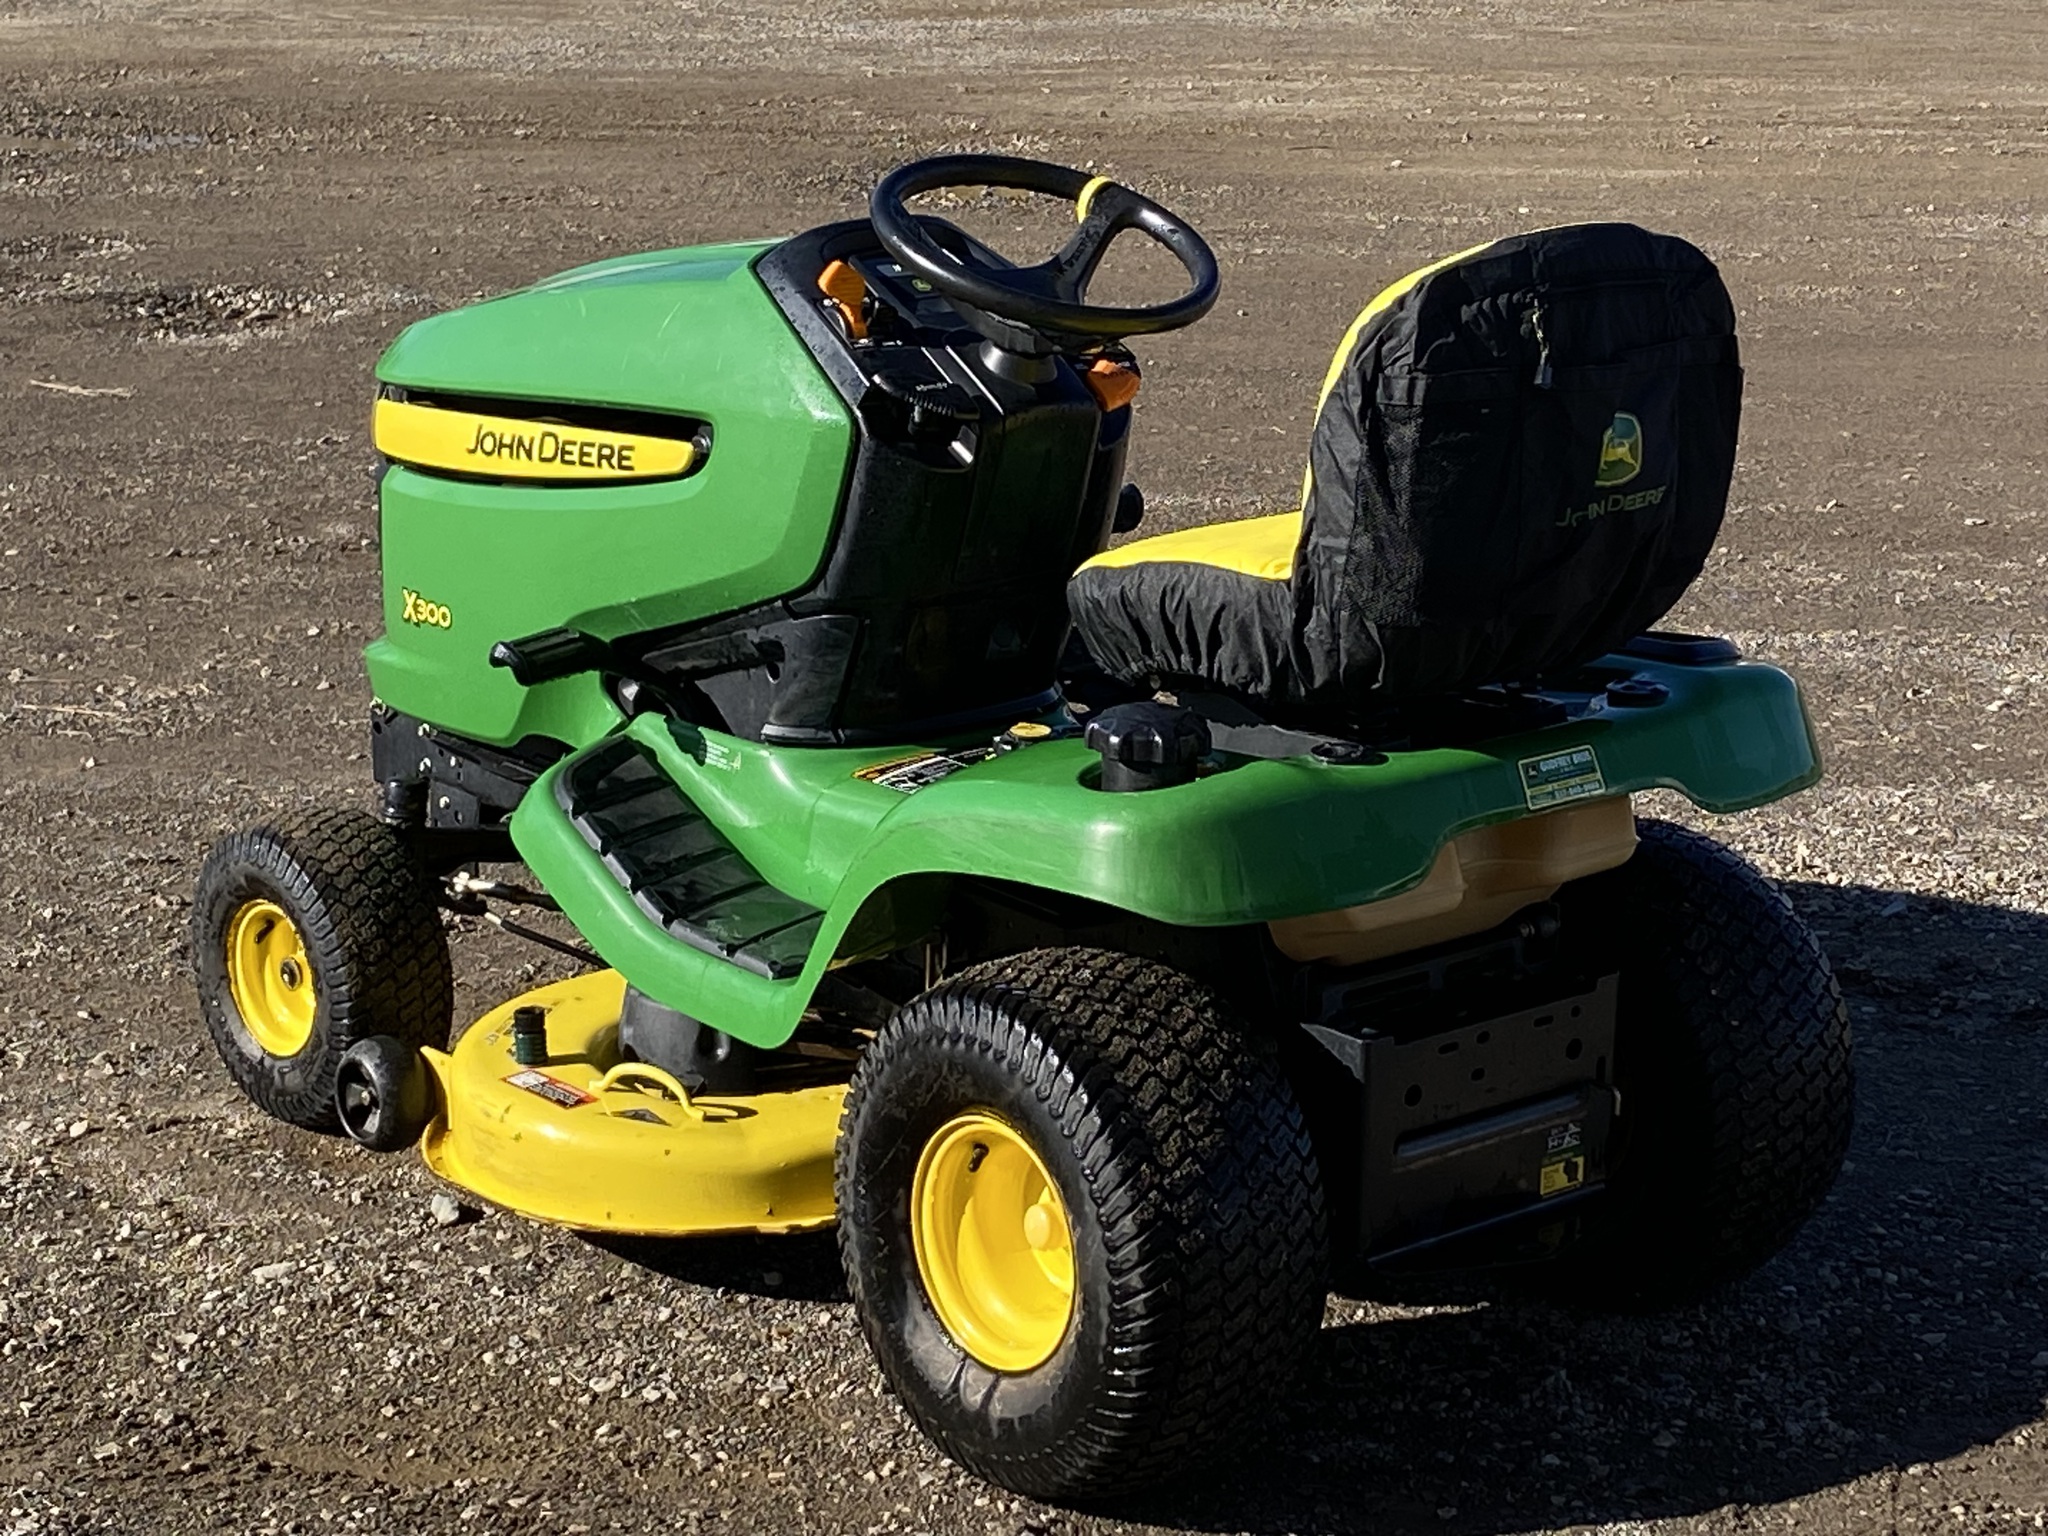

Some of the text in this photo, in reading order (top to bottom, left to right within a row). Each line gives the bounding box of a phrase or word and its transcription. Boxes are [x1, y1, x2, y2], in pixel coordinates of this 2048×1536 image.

[465, 424, 635, 471] JOHN DEERE
[1555, 499, 1606, 528] JN
[402, 588, 452, 629] X300
